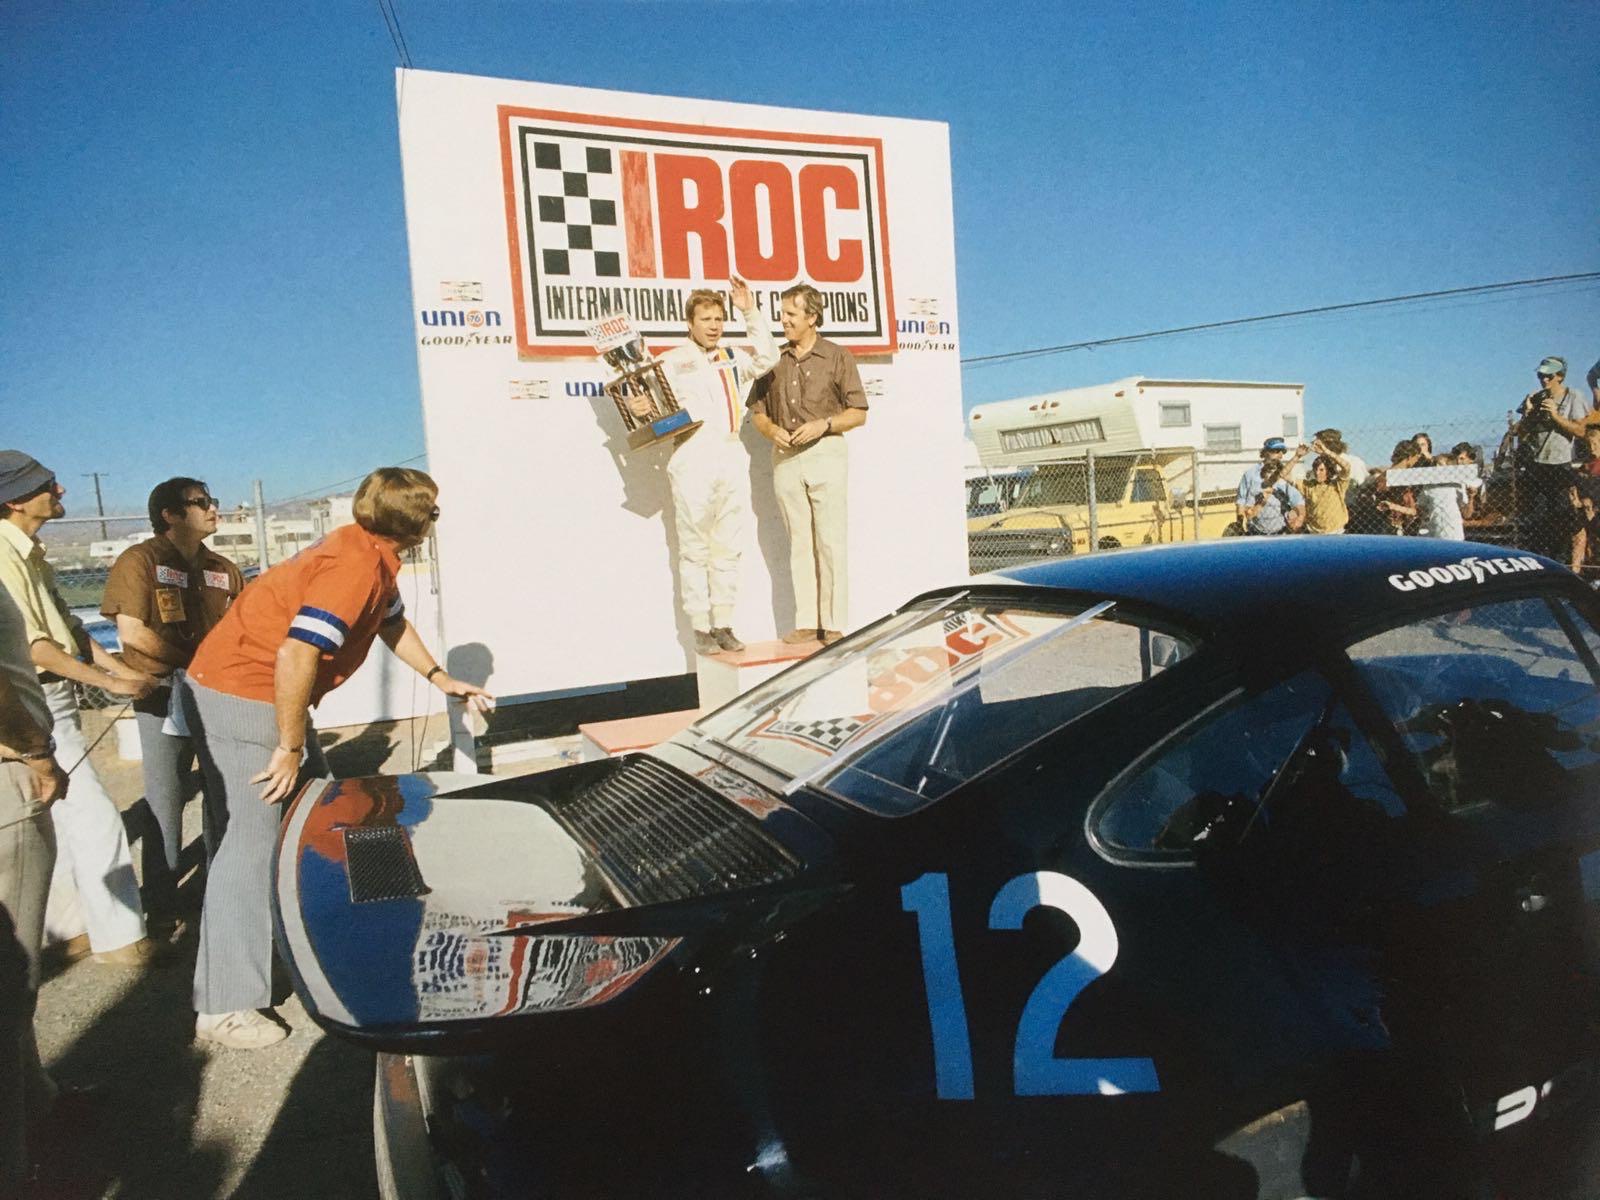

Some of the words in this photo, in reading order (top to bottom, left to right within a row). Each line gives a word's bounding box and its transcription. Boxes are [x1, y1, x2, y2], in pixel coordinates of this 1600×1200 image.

[619, 149, 864, 282] IROC
[545, 285, 688, 321] INTERNATIONAL
[770, 291, 868, 322] CPIONS
[898, 341, 956, 351] OODYEAR
[1388, 557, 1544, 591] GOODYEAR
[900, 871, 1160, 1100] 12
